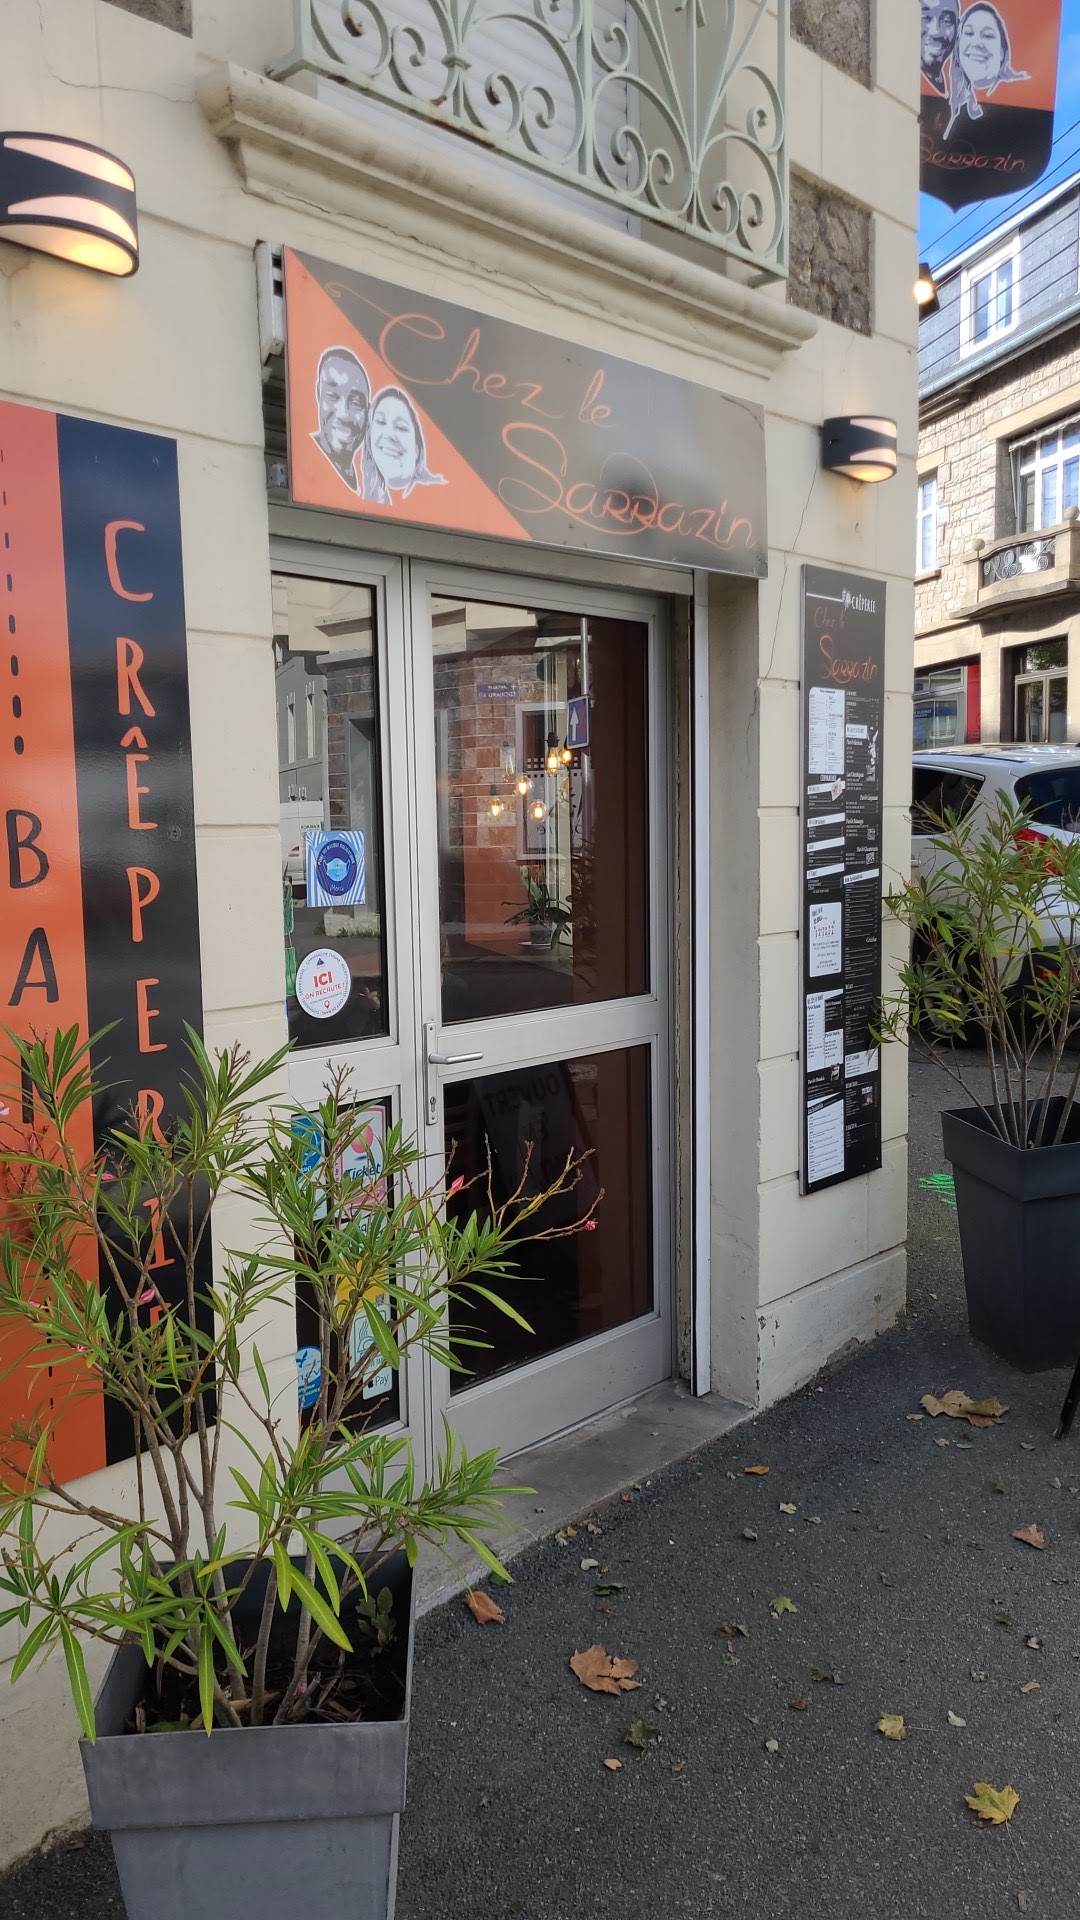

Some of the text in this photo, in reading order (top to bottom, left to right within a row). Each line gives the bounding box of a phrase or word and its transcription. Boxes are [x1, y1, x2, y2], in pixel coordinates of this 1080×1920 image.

[327, 281, 618, 428] Chez le
[104, 519, 176, 1372] CRÊPERI
[313, 971, 333, 988] ICI
[305, 991, 315, 1000] ON
[315, 983, 341, 997] RECRUTE
[375, 1375, 389, 1387] Pay
